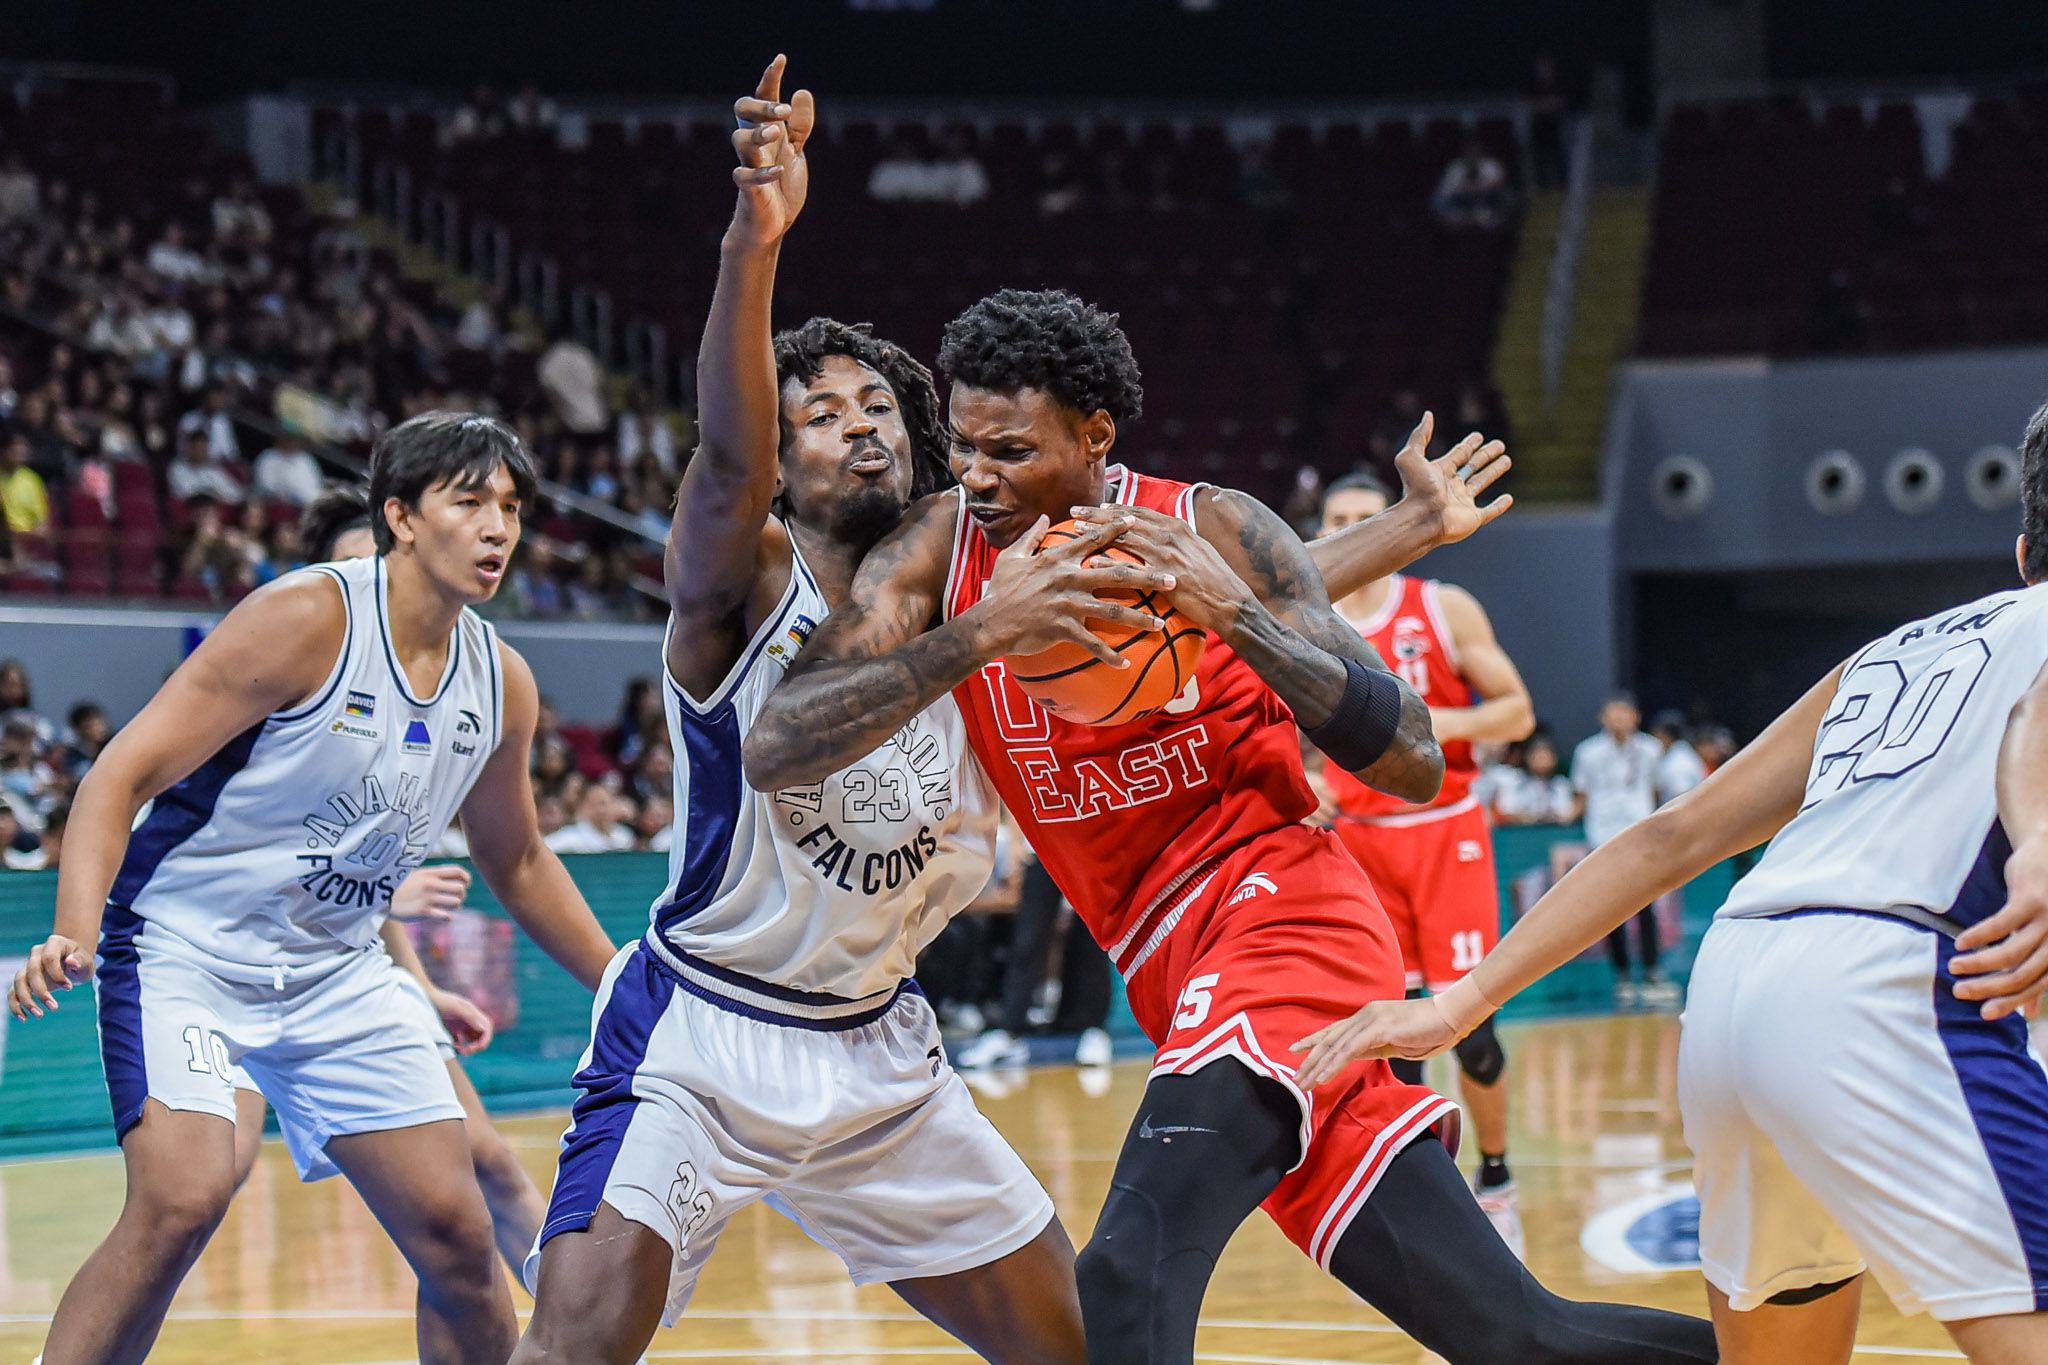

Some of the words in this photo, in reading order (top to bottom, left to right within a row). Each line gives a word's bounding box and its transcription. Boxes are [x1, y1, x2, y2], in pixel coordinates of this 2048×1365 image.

[347, 694, 375, 709] DAVIES
[1800, 637, 1992, 814] 20
[842, 768, 911, 823] 23
[1007, 723, 1210, 823] EAST
[344, 828, 399, 868] 10
[796, 825, 938, 896] FALCONS
[1451, 930, 1485, 971] 11
[182, 1026, 232, 1084] 10
